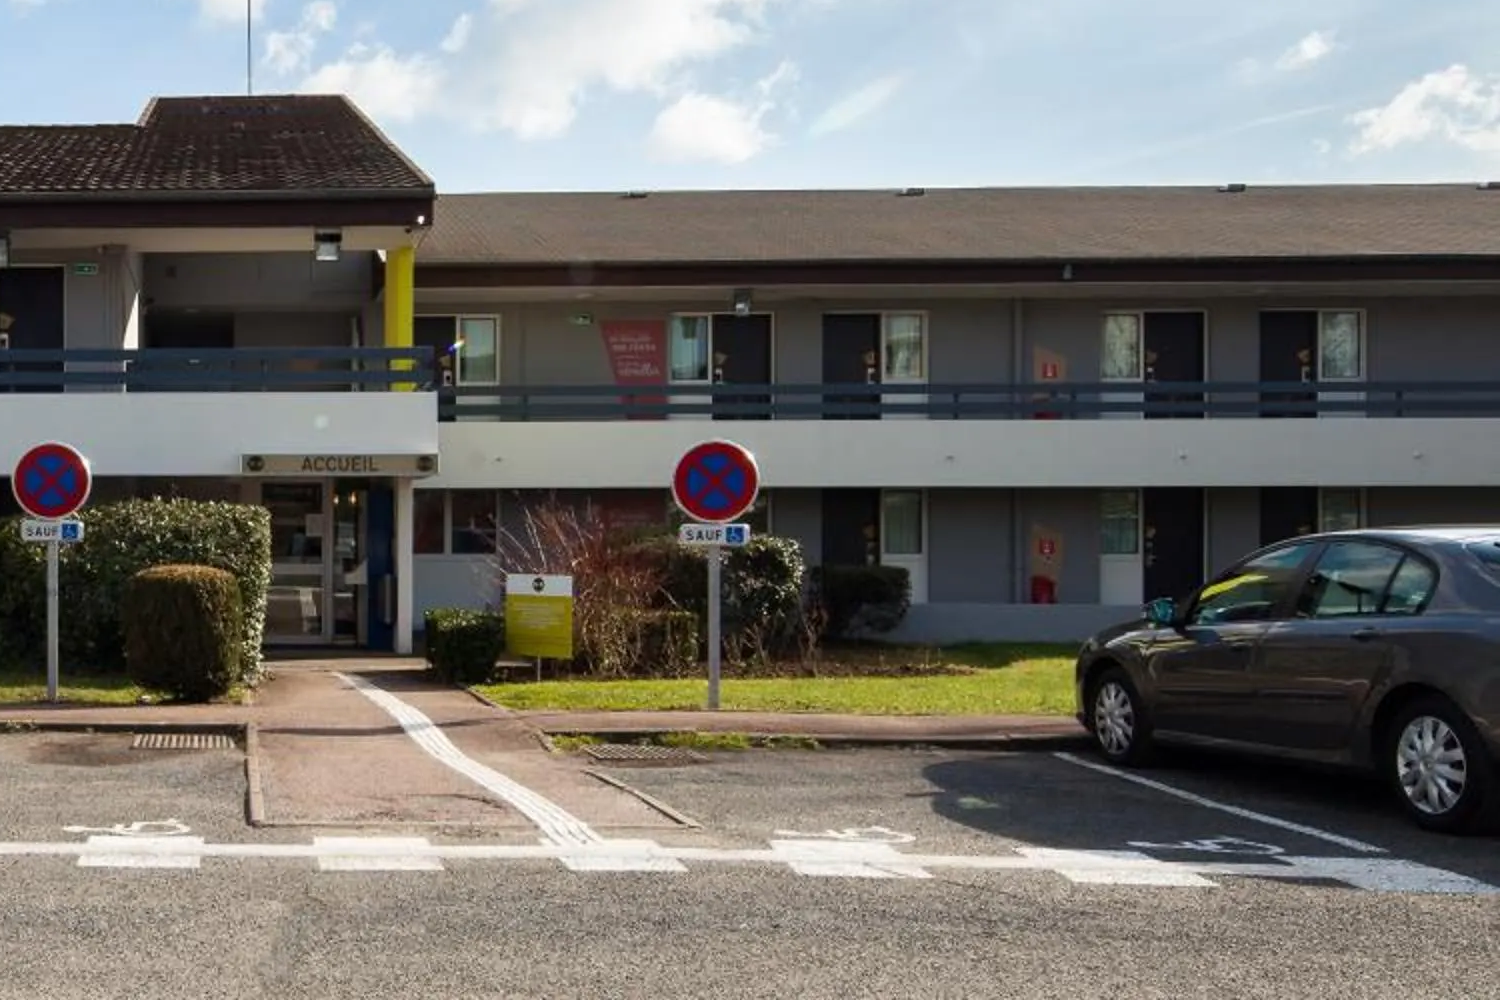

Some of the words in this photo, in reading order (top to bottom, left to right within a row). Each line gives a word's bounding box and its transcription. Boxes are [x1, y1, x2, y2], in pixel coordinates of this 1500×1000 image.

[301, 456, 378, 472] ACCUEIL
[26, 526, 58, 537] SAUF
[685, 529, 721, 541] SAUF
